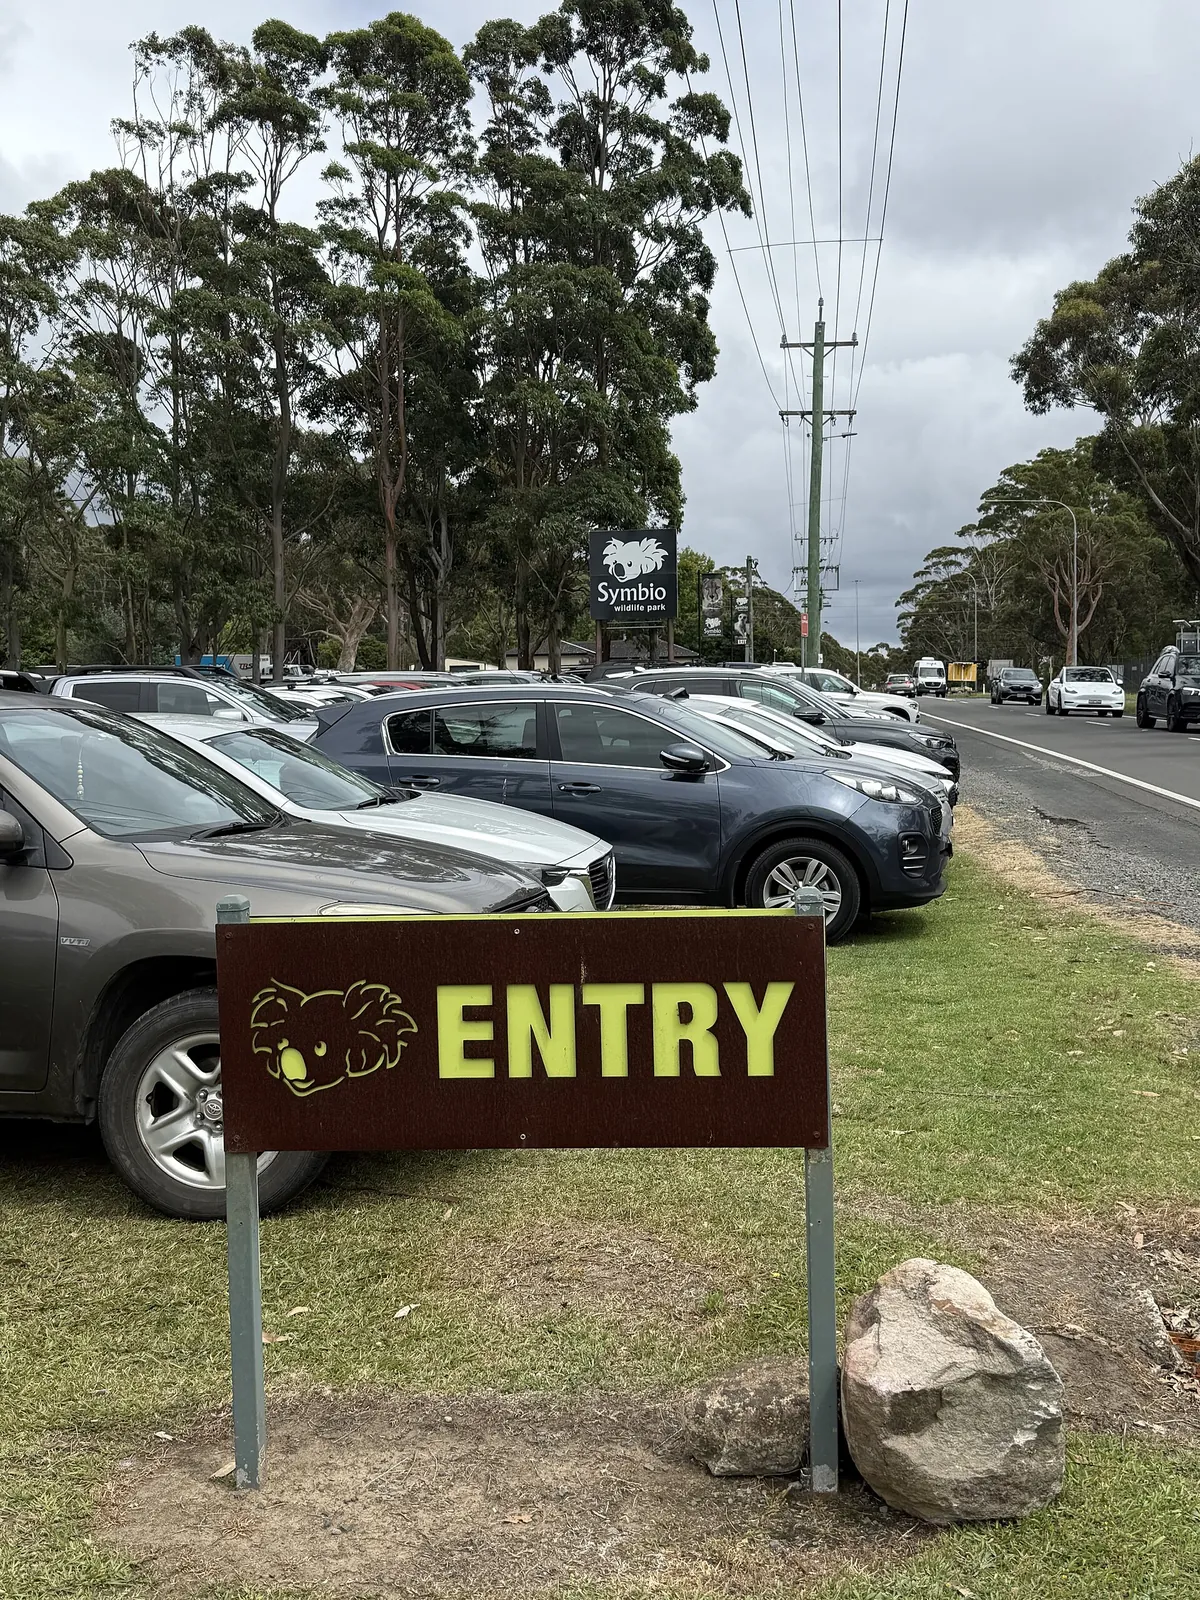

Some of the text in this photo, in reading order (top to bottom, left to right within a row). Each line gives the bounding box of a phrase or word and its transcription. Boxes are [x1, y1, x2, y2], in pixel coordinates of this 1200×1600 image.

[597, 582, 667, 605] Symbio
[614, 603, 666, 613] wildlife park
[436, 981, 796, 1079] ENTRY
